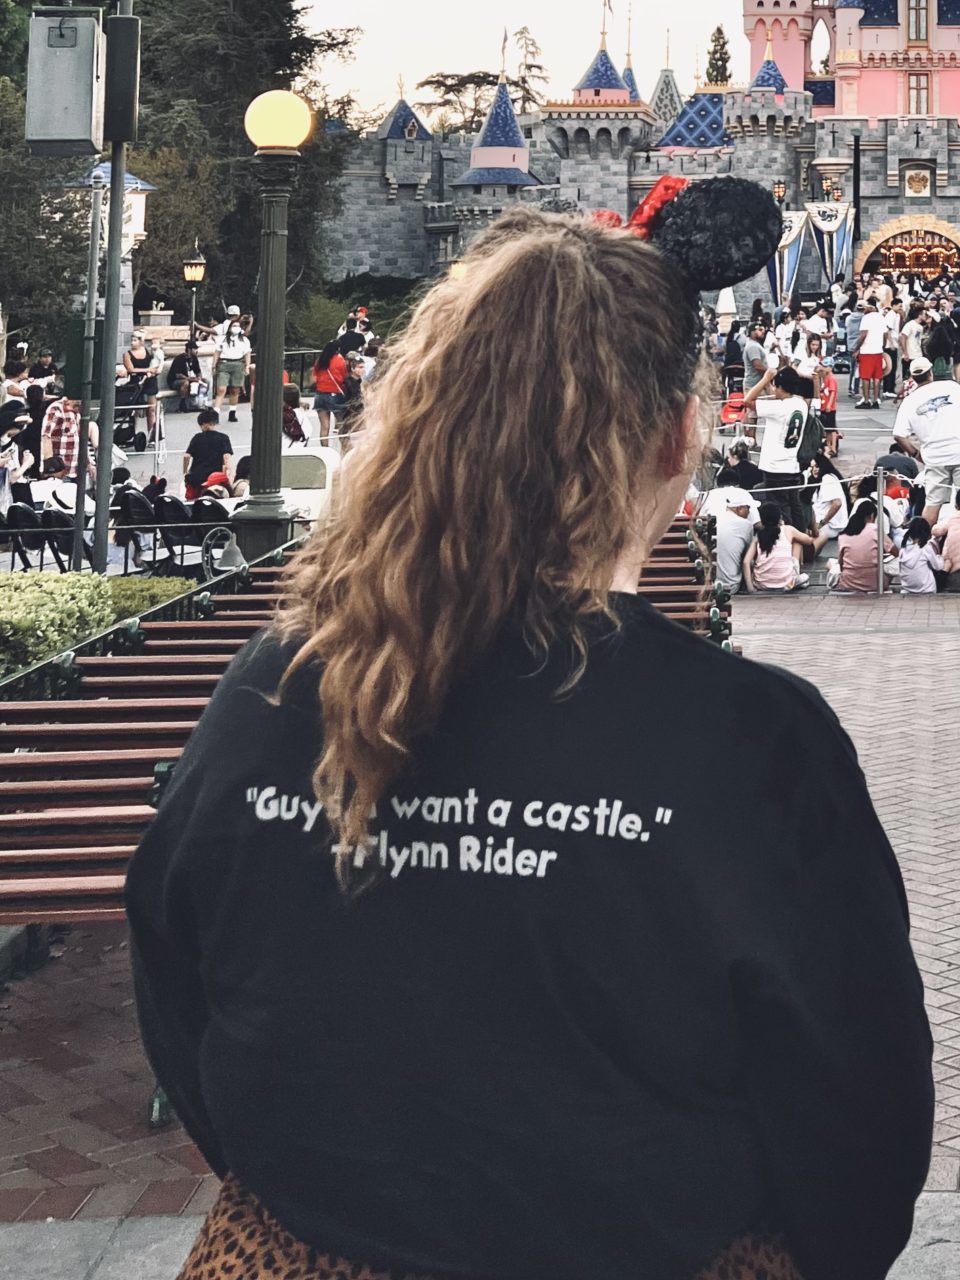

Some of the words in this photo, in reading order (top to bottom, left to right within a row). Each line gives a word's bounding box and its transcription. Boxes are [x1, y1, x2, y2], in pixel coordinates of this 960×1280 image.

[391, 787, 479, 825] want
[487, 798, 513, 828] a
[523, 797, 673, 843] castle."
[459, 835, 558, 878] Rider
